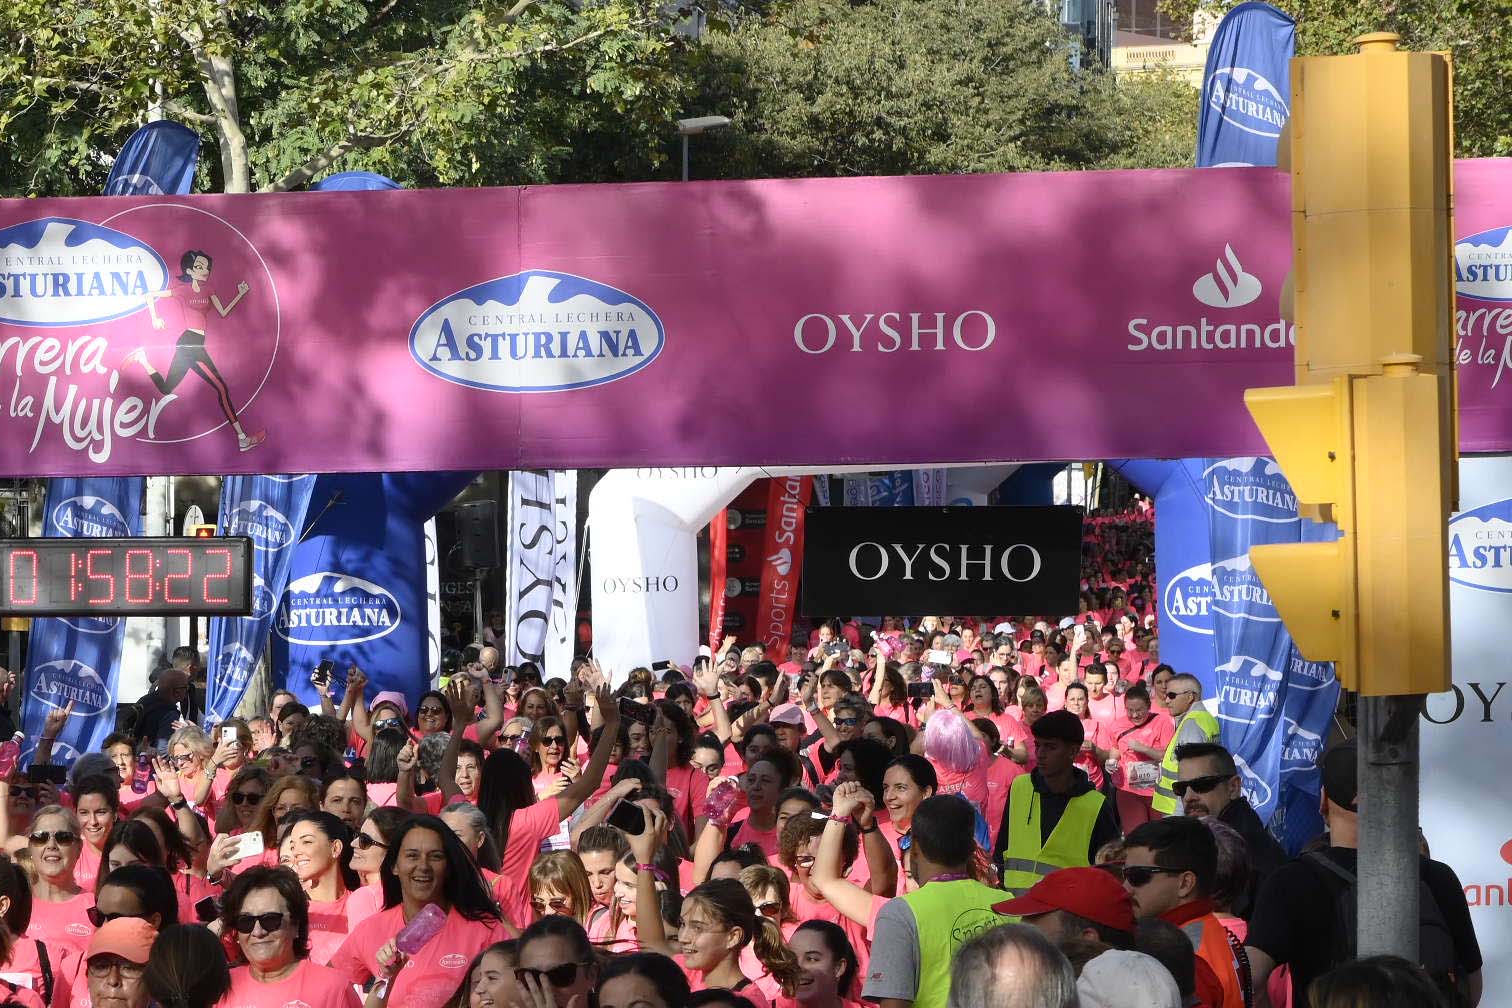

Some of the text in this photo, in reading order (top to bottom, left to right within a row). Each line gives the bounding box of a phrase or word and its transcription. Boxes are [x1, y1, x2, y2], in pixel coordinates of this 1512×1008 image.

[71, 254, 145, 267] LECHERA
[468, 310, 637, 327] CENTRAL LECHERA
[793, 309, 997, 354] OYSHO
[1126, 317, 1296, 351] Santand
[428, 317, 645, 363] ASTURIANA
[1478, 337, 1496, 366] la
[9, 379, 35, 419] la
[29, 369, 180, 464] Mujer
[8, 548, 233, 604] 01:58:22
[848, 541, 1042, 582] OYSHO
[291, 597, 387, 606] CENTRAL LECHERA
[603, 575, 679, 594] OYSHO
[280, 601, 392, 629] ASTURIANA
[33, 672, 104, 709] ASTURIANA
